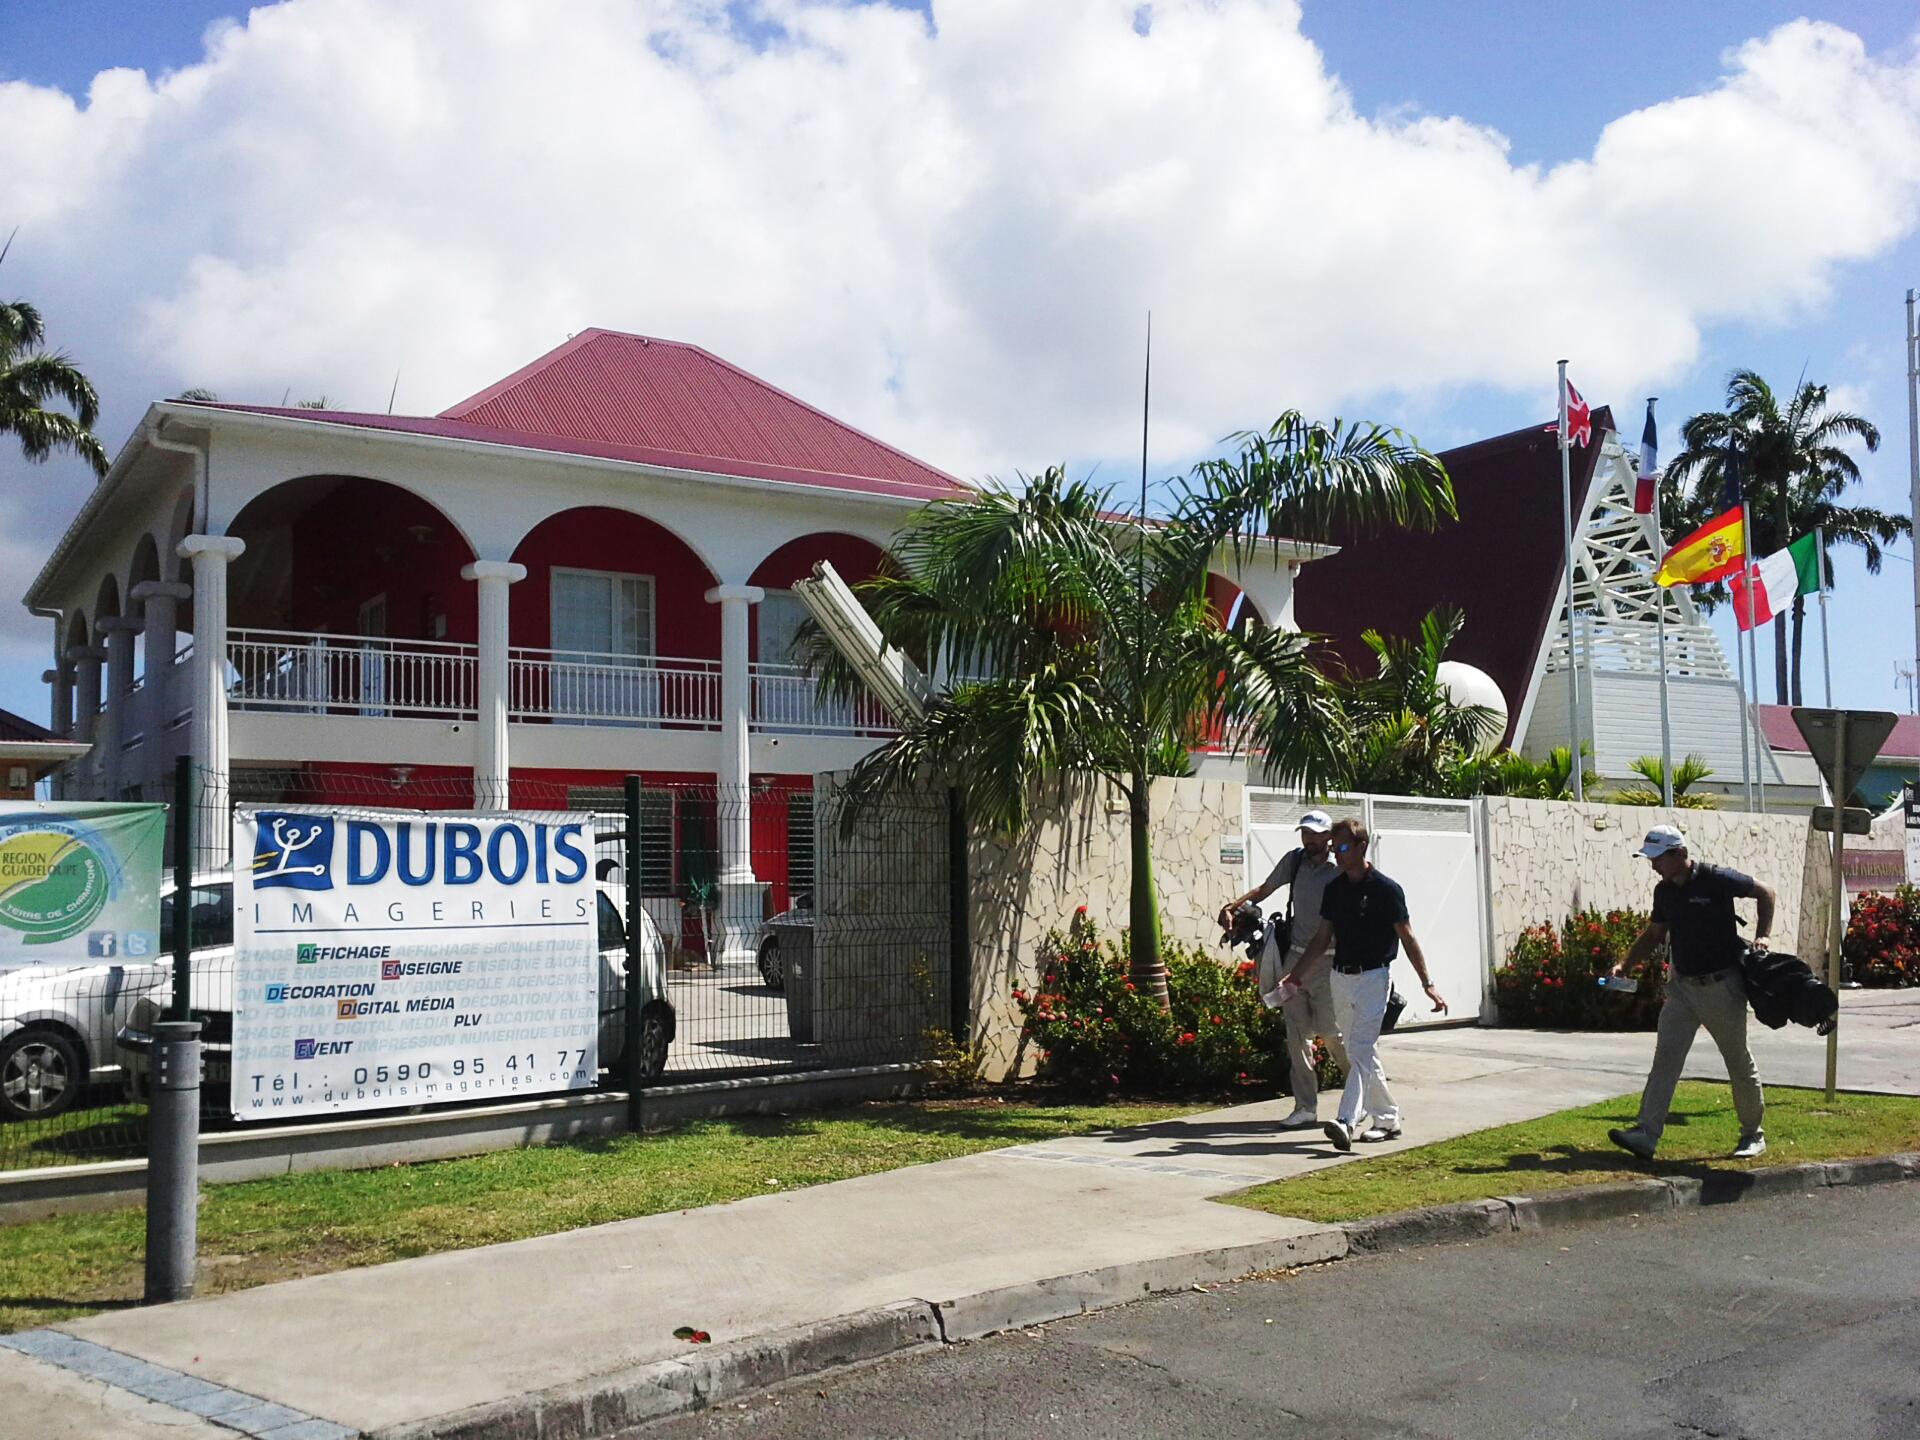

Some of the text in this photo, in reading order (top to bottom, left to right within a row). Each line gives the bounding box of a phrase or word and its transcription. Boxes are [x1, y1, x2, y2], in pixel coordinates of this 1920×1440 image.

[2, 852, 47, 864] REGION
[347, 822, 587, 886] DUBOIS
[1, 864, 77, 876] GUADELOUPE
[7, 858, 95, 919] TERRE DE CHAMPIONS
[254, 898, 586, 924] IMAGERIES
[299, 945, 391, 960] AFFICHAGE
[395, 943, 479, 957] AFFICHAGE
[293, 964, 378, 980] ENSEIGNE
[383, 961, 462, 976] ENSEIGNE
[467, 957, 541, 973] ENSEIGNE
[267, 983, 375, 1000] DÉCORATION
[381, 981, 409, 995] PLV
[413, 977, 504, 993] BANDEROLE
[265, 1004, 336, 1019] FORMAT
[340, 1001, 400, 1016] DIGITAL
[405, 996, 455, 1012] MÉDIA
[298, 1023, 329, 1038] PLV
[333, 1020, 394, 1036] DIGITAL
[454, 1013, 482, 1027] PLV
[486, 1009, 555, 1025] LOCATION
[296, 1041, 353, 1057] EVENT
[358, 1034, 455, 1053] IMPRESSION
[354, 1062, 431, 1084] 0590
[453, 1058, 484, 1075] 95
[506, 1053, 534, 1070] 41
[557, 1050, 586, 1067] 77
[252, 1070, 586, 1107] www.duboisimageries.com
